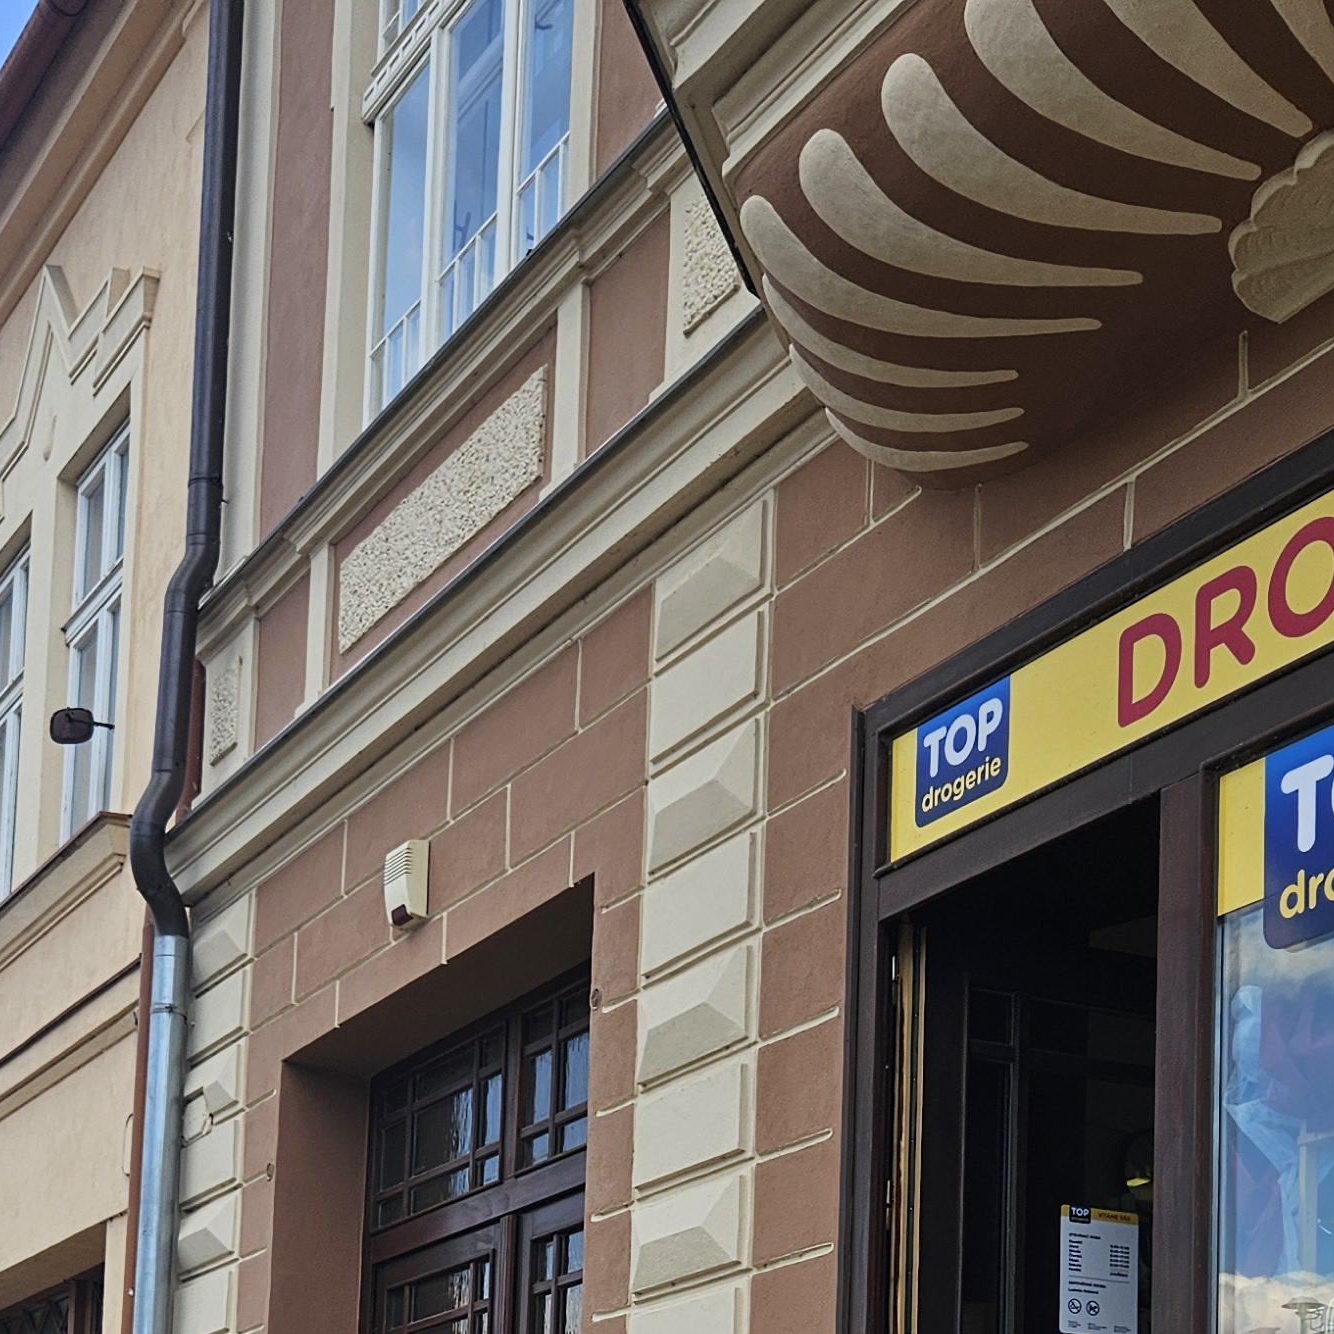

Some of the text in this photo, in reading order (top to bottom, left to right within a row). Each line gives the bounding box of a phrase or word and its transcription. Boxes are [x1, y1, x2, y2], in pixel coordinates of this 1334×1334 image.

[923, 696, 1005, 778] TOP
[921, 755, 1002, 812] drogerie
[1071, 1207, 1090, 1217] TOP
